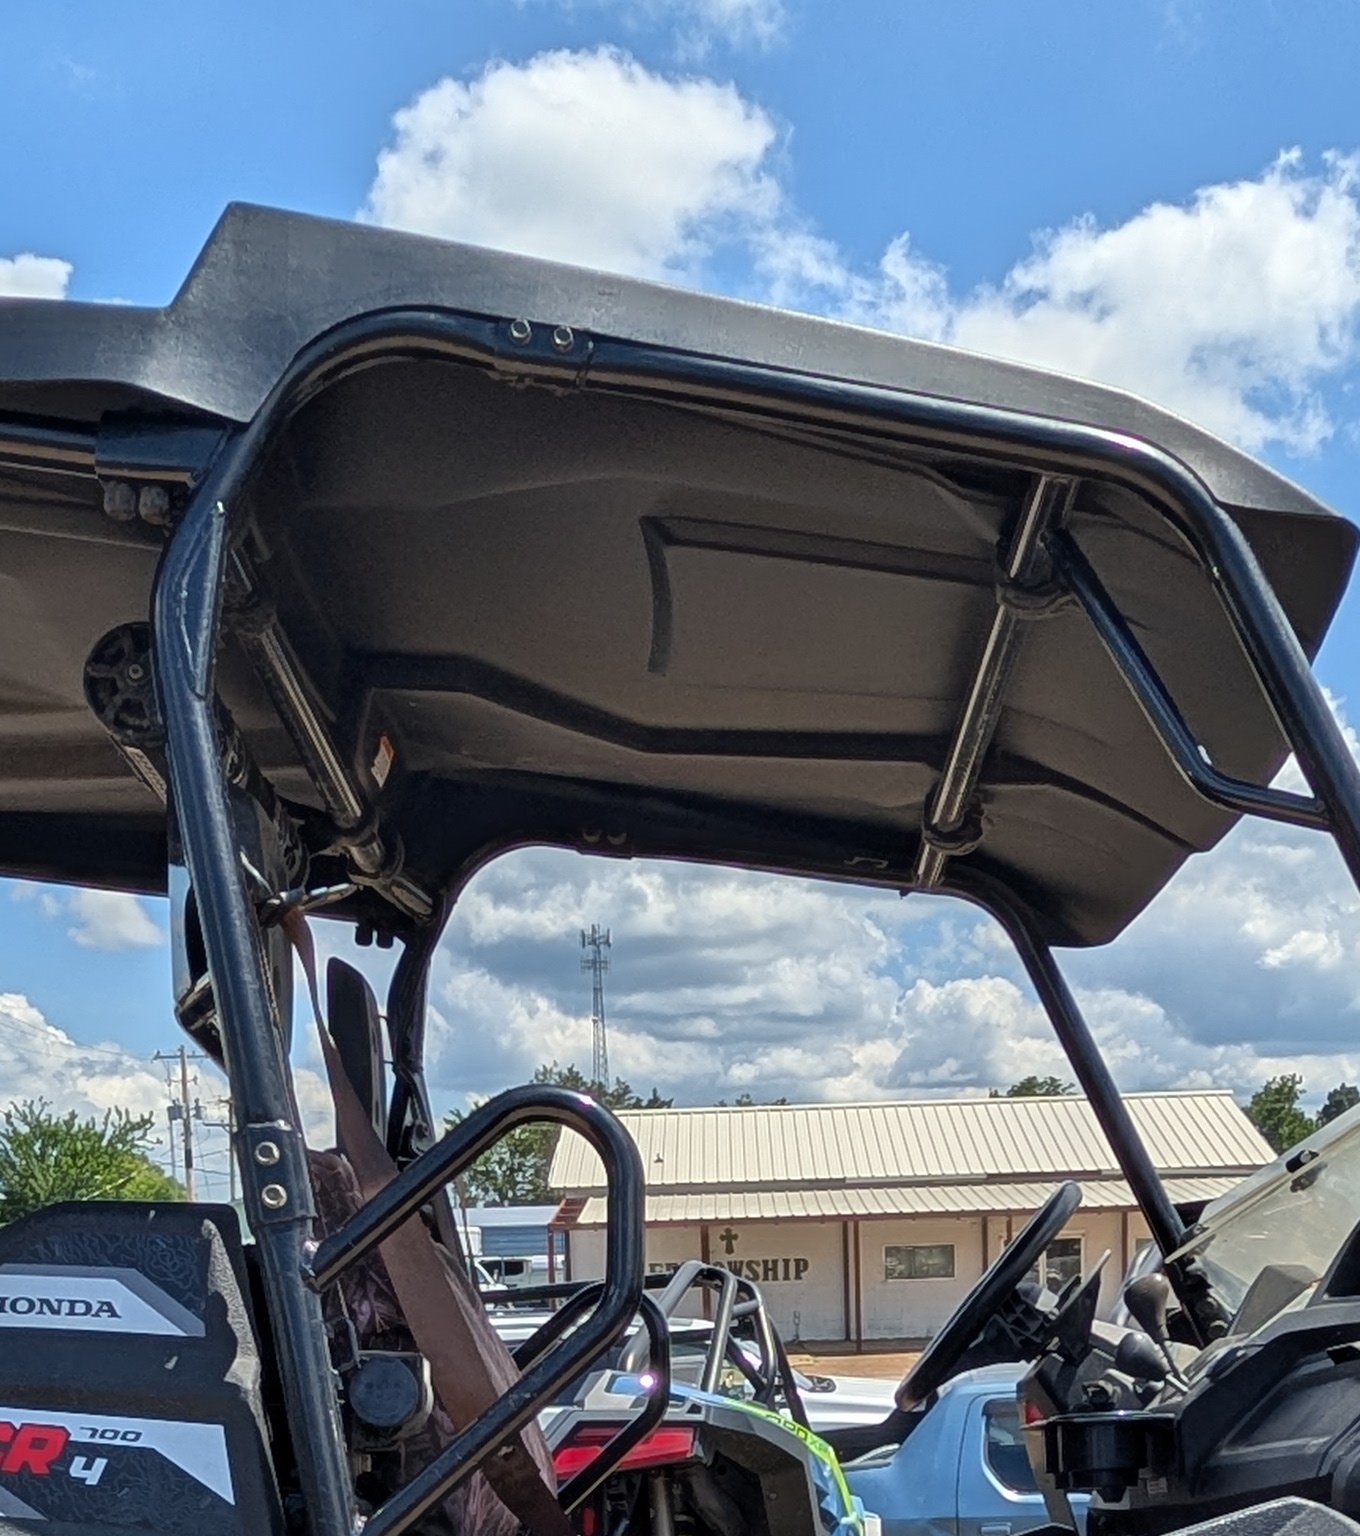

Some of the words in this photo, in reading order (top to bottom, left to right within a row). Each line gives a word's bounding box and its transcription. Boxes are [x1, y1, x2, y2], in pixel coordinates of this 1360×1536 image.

[649, 1257, 809, 1282] WSHIP
[79, 1426, 143, 1443] 700
[69, 1455, 108, 1486] 4
